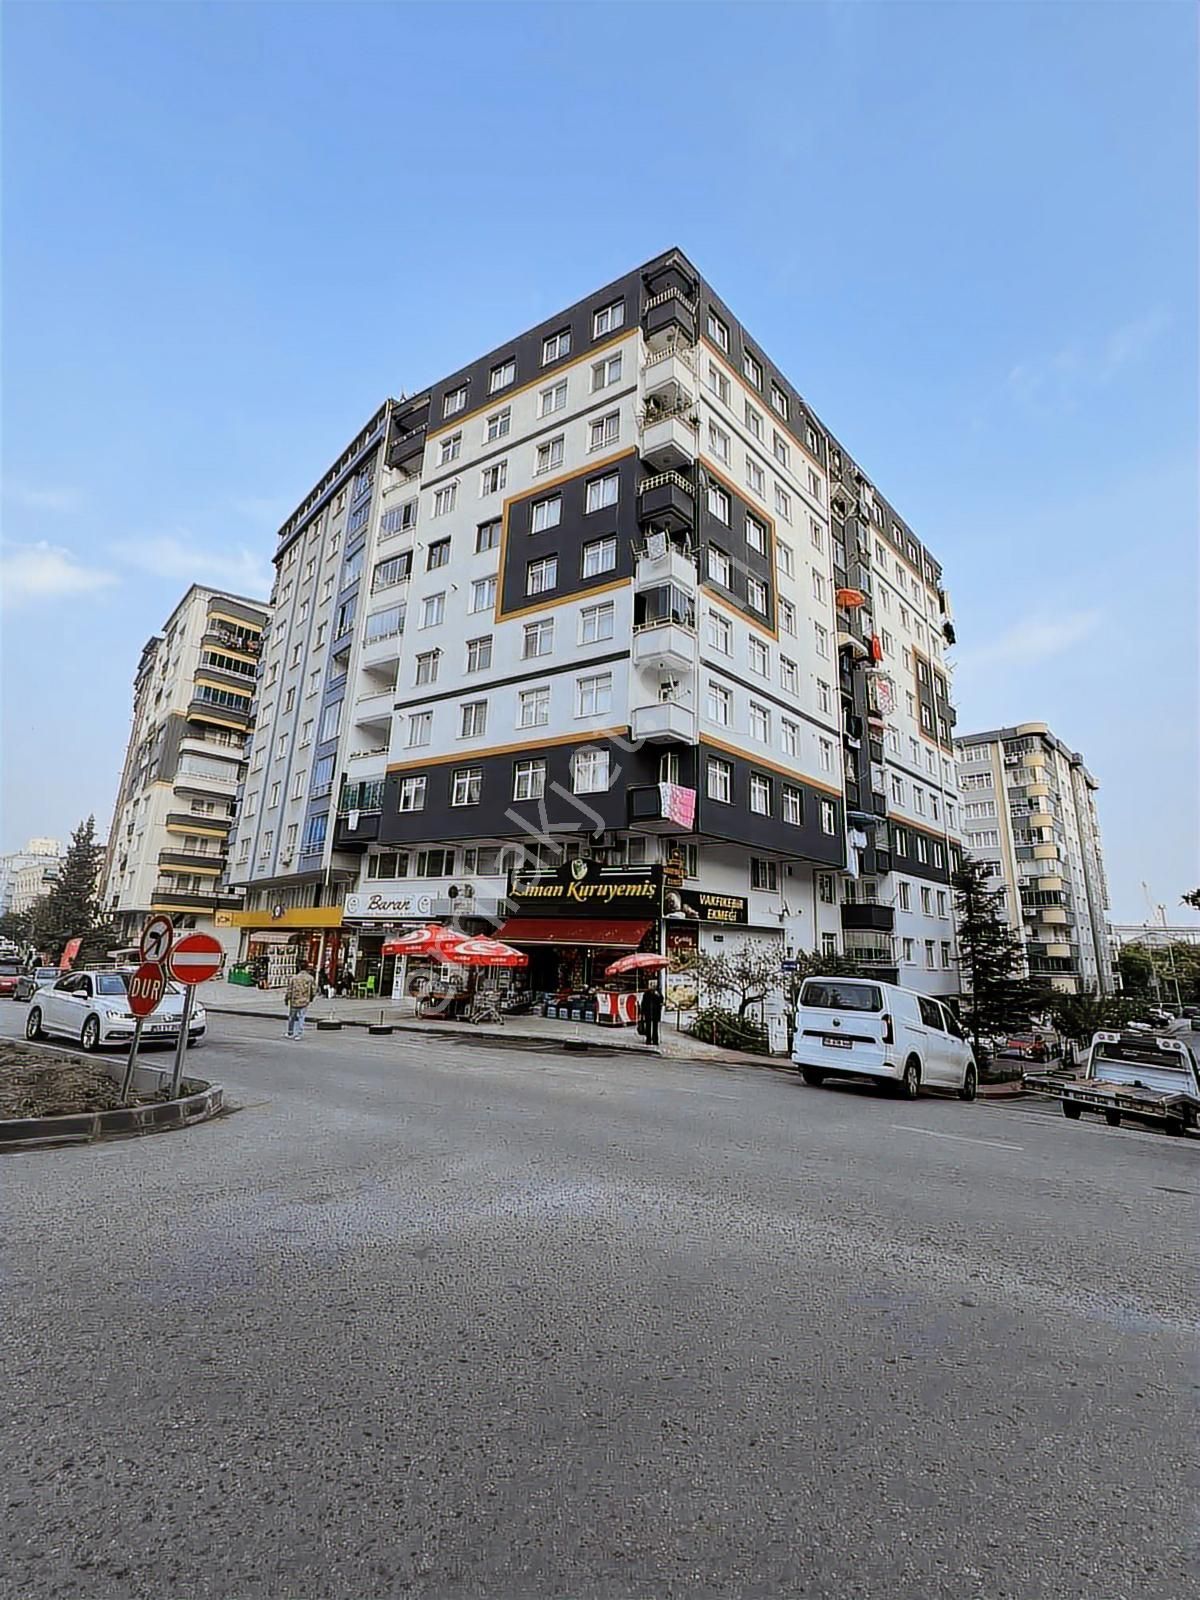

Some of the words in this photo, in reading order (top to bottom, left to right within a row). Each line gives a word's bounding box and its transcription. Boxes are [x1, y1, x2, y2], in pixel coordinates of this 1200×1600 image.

[367, 894, 411, 911] Baran
[509, 878, 563, 897] Liman
[566, 879, 657, 903] Kuruyemiş
[131, 977, 161, 1001] DUR
